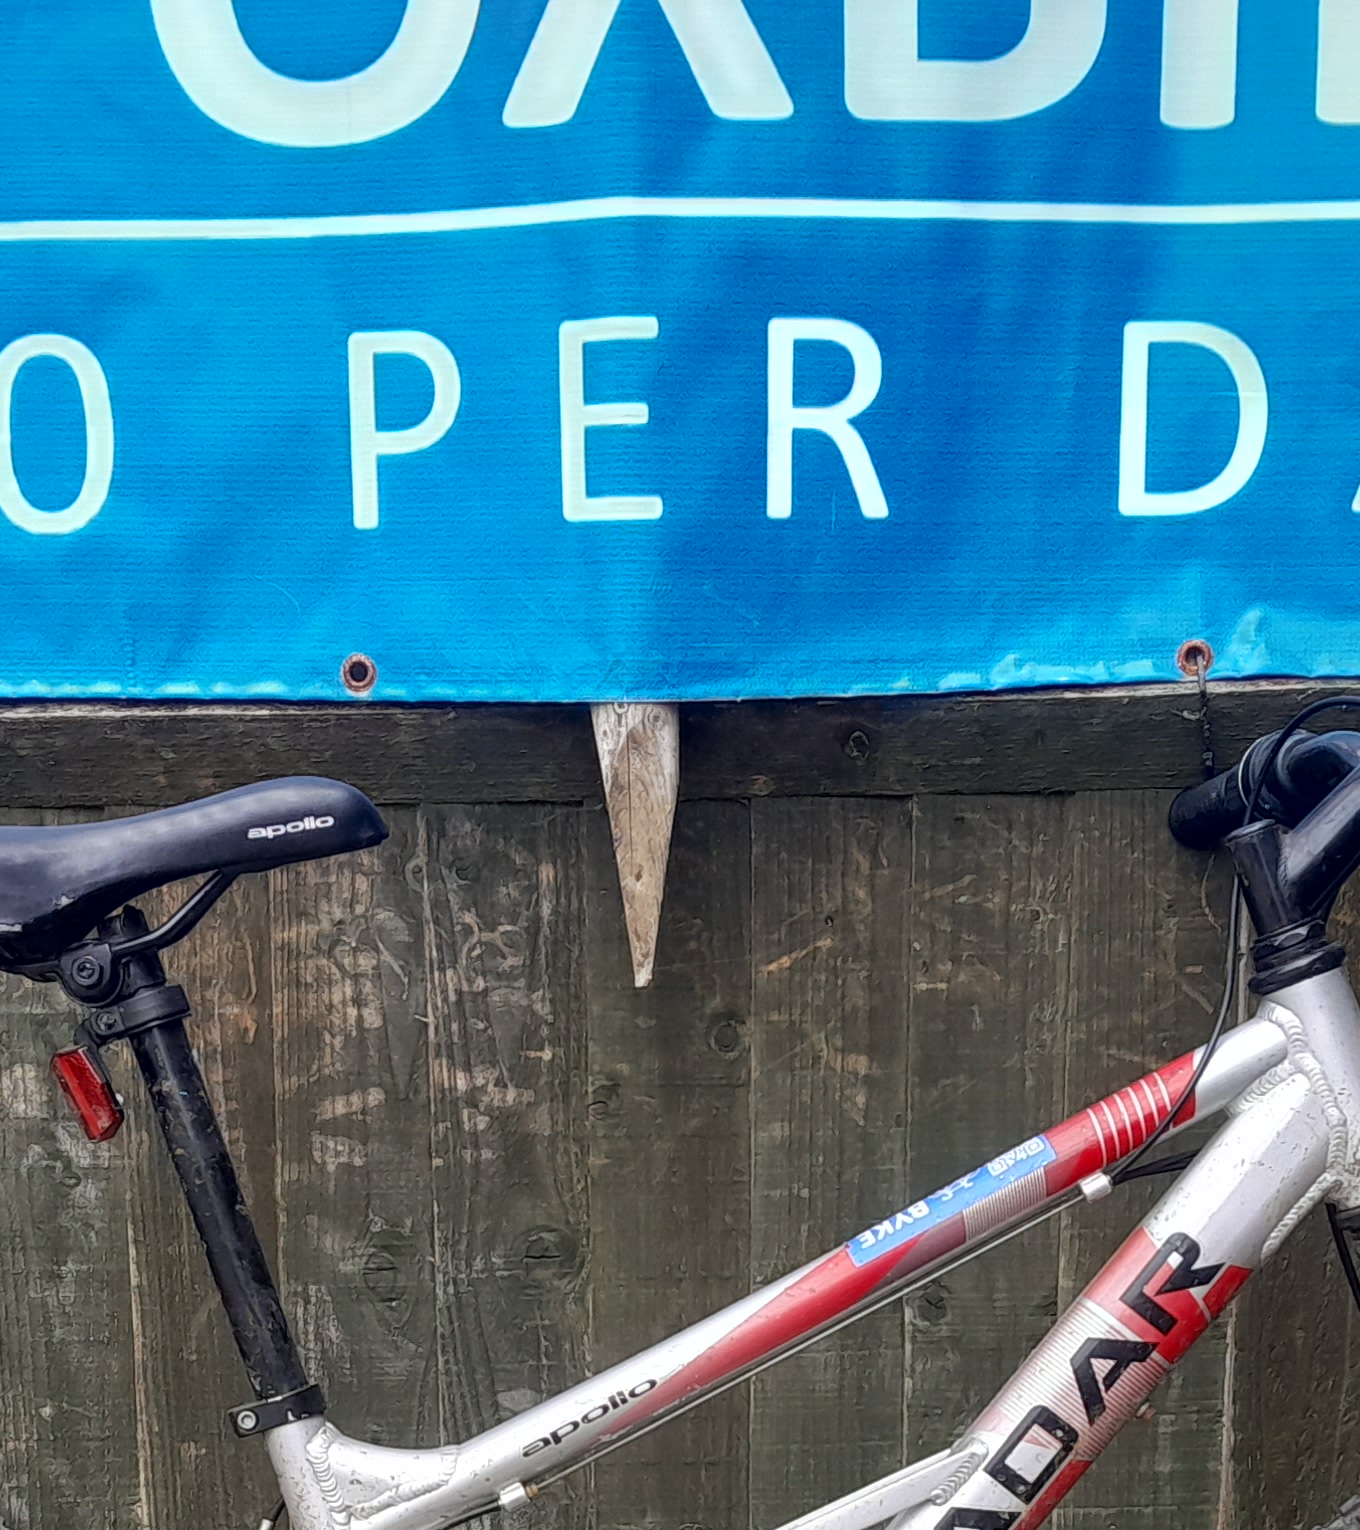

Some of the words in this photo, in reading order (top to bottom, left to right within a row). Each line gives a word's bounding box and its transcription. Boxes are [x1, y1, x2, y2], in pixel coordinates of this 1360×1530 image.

[348, 317, 889, 531] PER
[248, 815, 335, 839] apollo
[858, 1198, 930, 1250] BYKE
[521, 1378, 658, 1459] apollo
